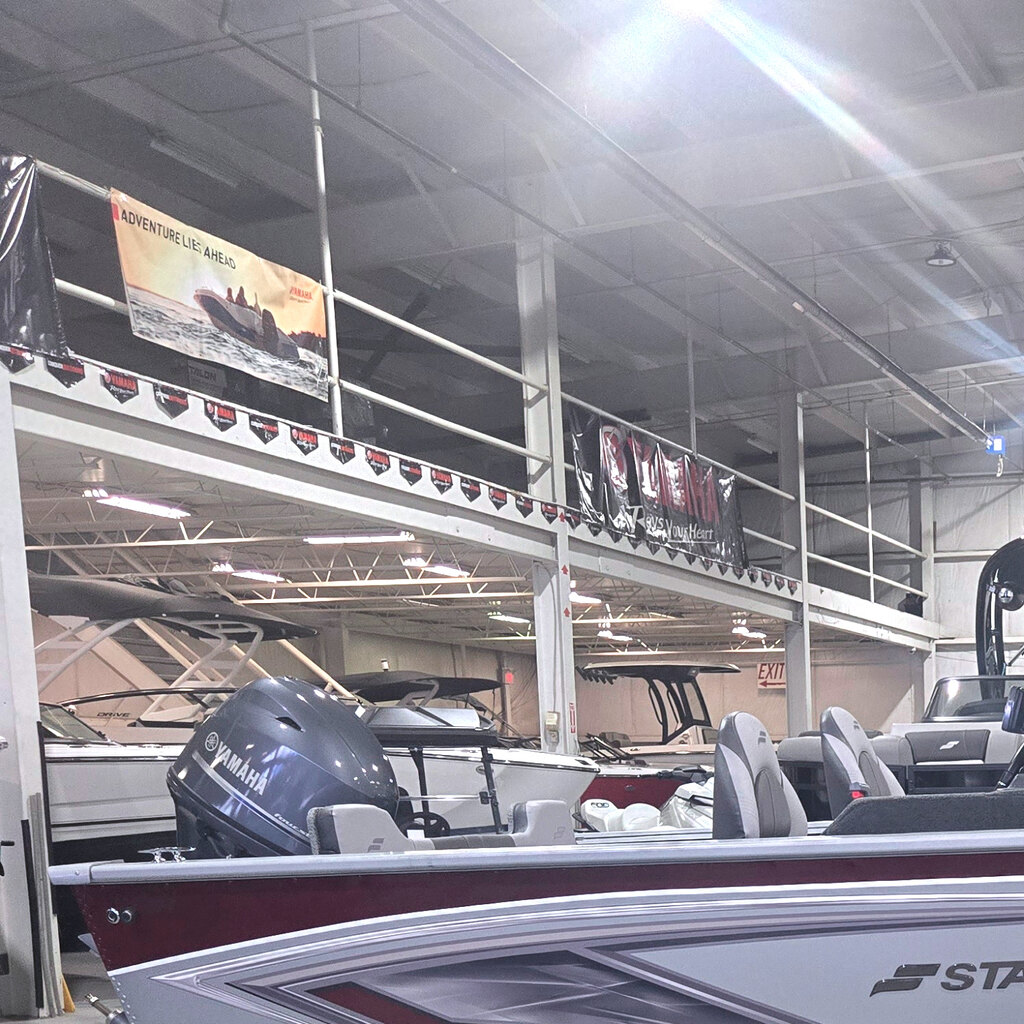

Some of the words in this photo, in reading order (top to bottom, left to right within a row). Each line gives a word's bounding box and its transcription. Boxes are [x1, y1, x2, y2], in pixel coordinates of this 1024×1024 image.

[120, 208, 181, 246] ADVENTURE
[182, 234, 202, 254] LIES
[203, 246, 236, 271] AHEAD
[689, 523, 714, 540] Heart
[757, 662, 785, 680] EXIT
[214, 741, 268, 796] YAMAHA
